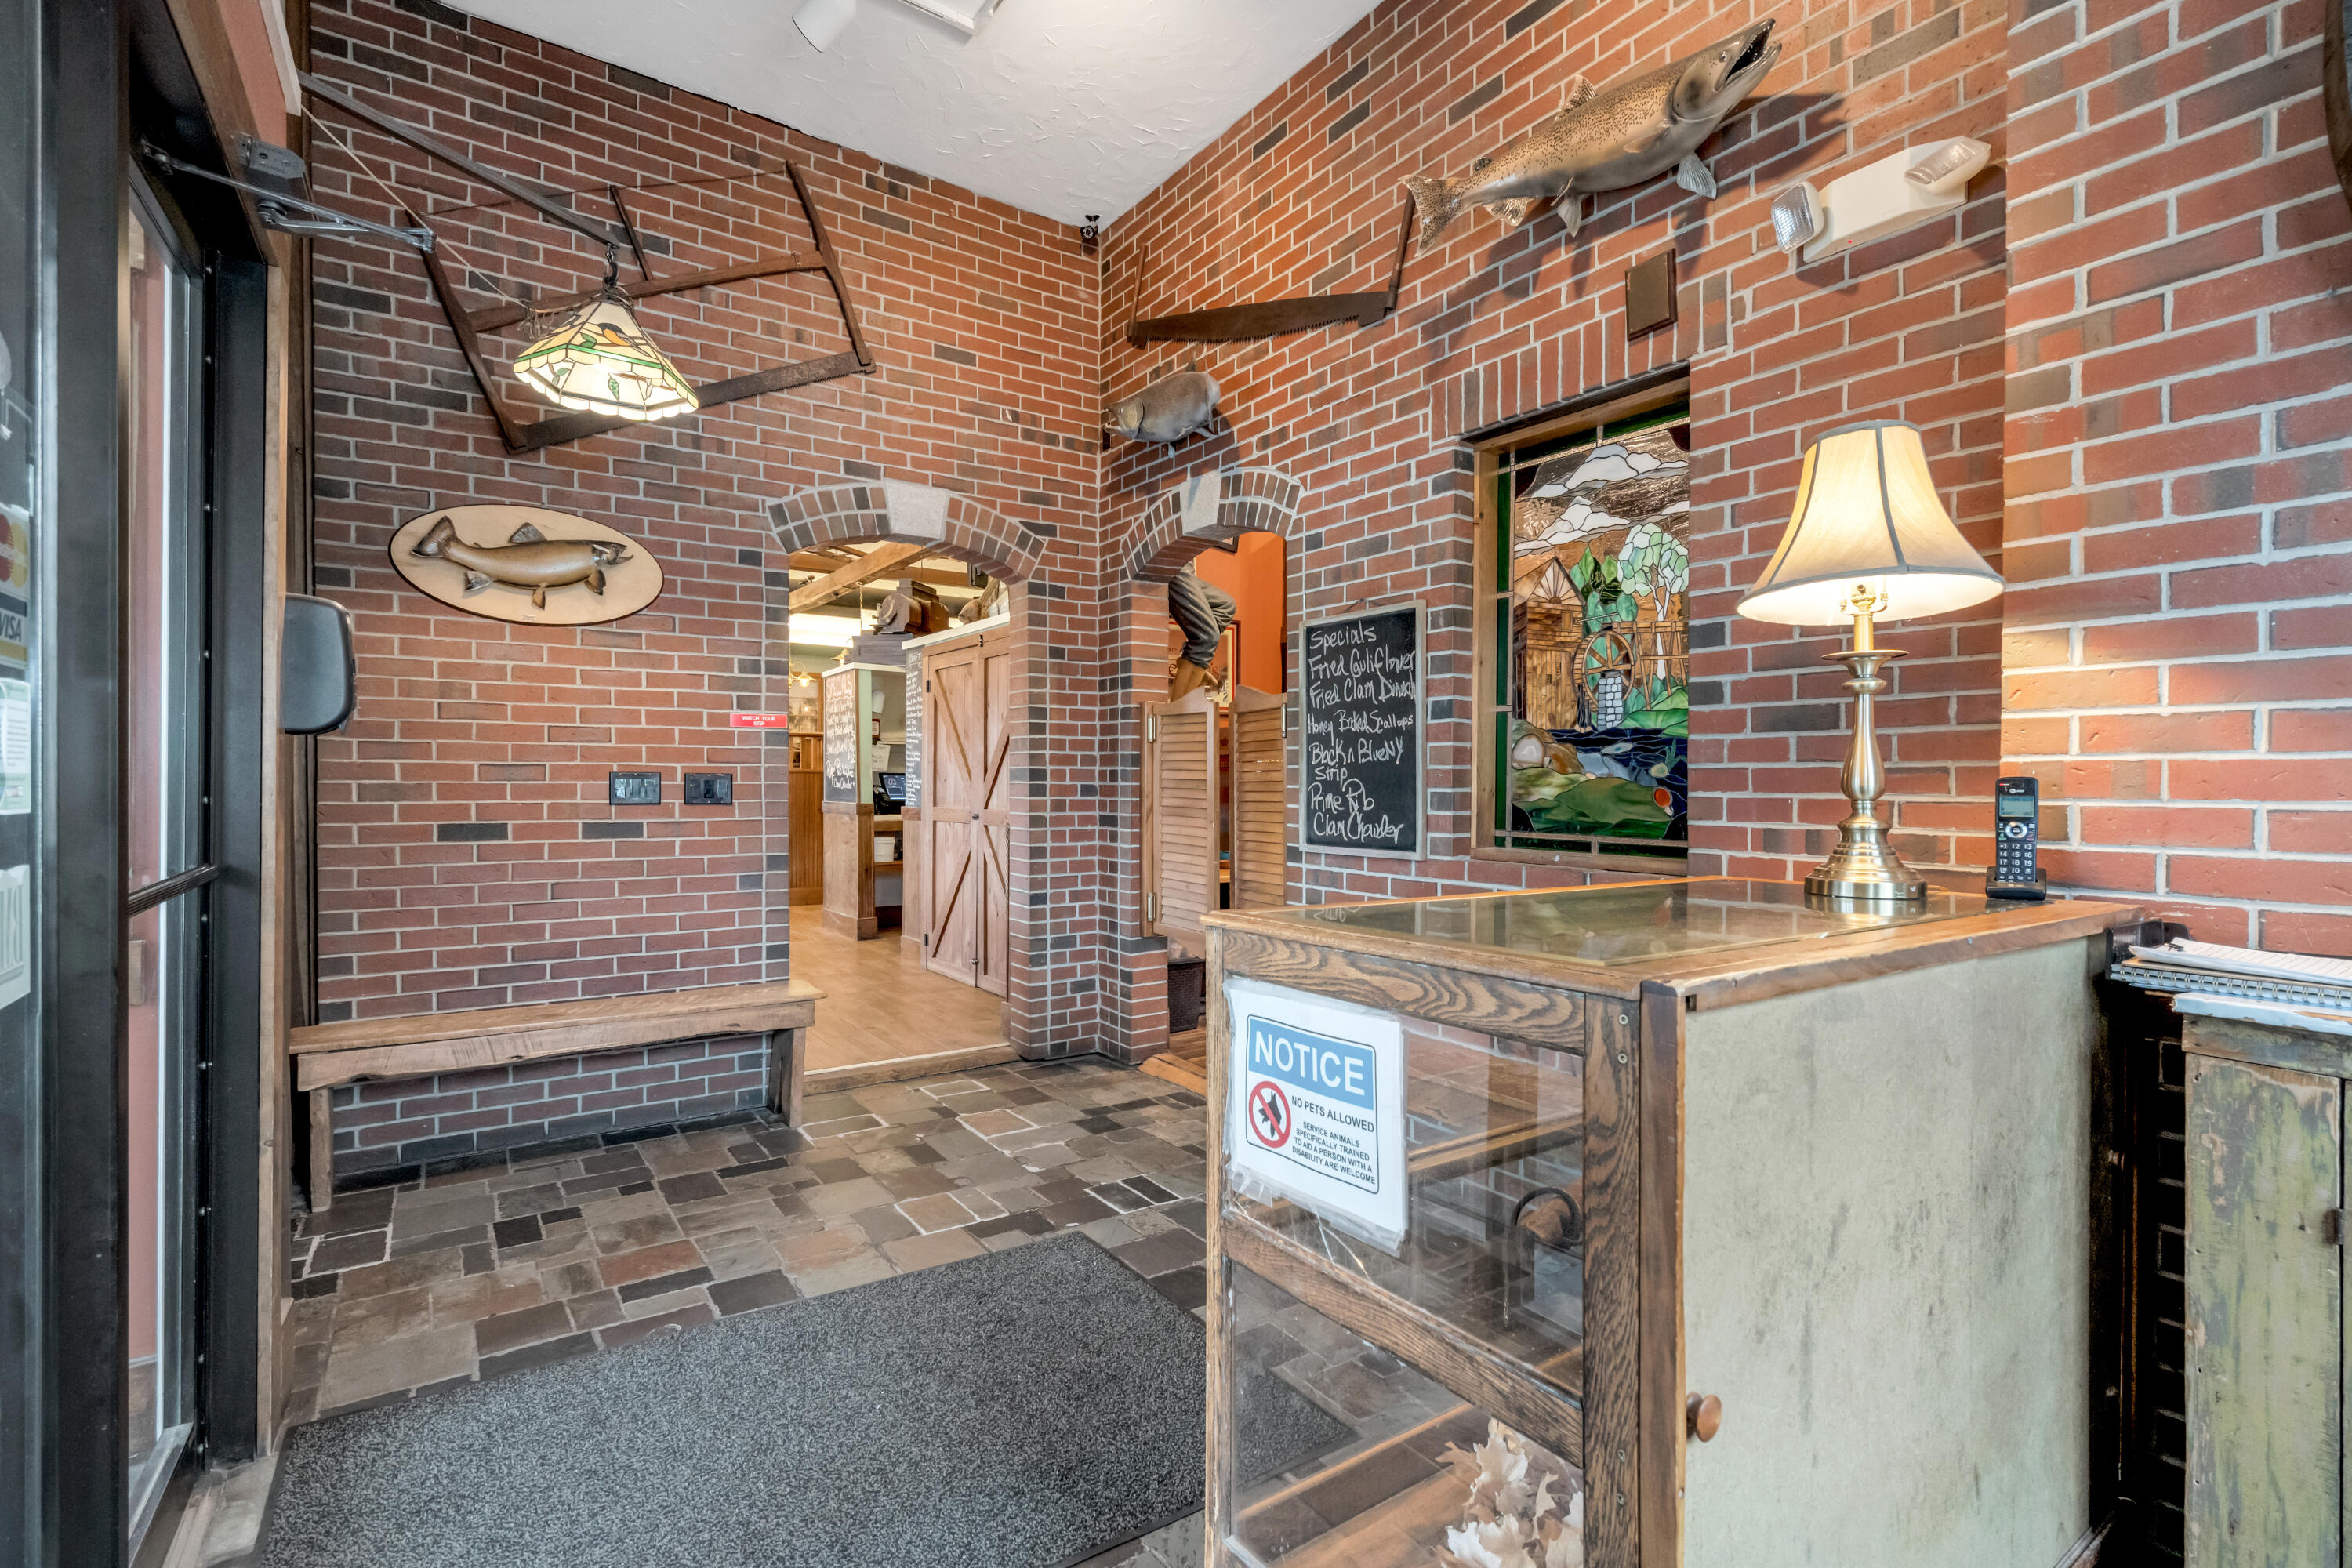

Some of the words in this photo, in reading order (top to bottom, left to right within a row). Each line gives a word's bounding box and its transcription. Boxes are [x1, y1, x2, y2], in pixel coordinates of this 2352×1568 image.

[1309, 620, 1377, 655] Specials
[1308, 655, 1349, 679] Fried
[1309, 681, 1341, 708] Fried
[1343, 677, 1378, 705] Clam
[1308, 713, 1334, 746] Honey
[1334, 709, 1370, 733] Baked
[1367, 710, 1414, 734] Scallops
[1358, 737, 1385, 764] Blue
[1384, 735, 1403, 765] NY
[1314, 764, 1348, 788] Strip
[1308, 781, 1345, 814] Prime
[1341, 778, 1374, 814] Rib
[1313, 811, 1349, 841] Clam
[1347, 810, 1404, 844] Chowder
[1254, 1030, 1366, 1097] NOTICE
[1291, 1095, 1302, 1109] NO
[1305, 1101, 1325, 1116] PETS
[1327, 1109, 1374, 1132] ALLOWED
[1296, 1127, 1338, 1150] SPECIFICALLY
[1339, 1144, 1370, 1161] TRAINED
[1303, 1121, 1328, 1138] SERVICE
[1330, 1132, 1360, 1148] ANIMALS
[1292, 1145, 1323, 1165] DISABILITY
[1324, 1160, 1338, 1171] ARE
[1340, 1164, 1376, 1185] WELCOME
[1294, 1136, 1302, 1146] TO
[1302, 1141, 1312, 1151] AID
[1319, 1147, 1347, 1163] PERSON
[1348, 1157, 1367, 1171] WITH
[1367, 1164, 1373, 1173] A
